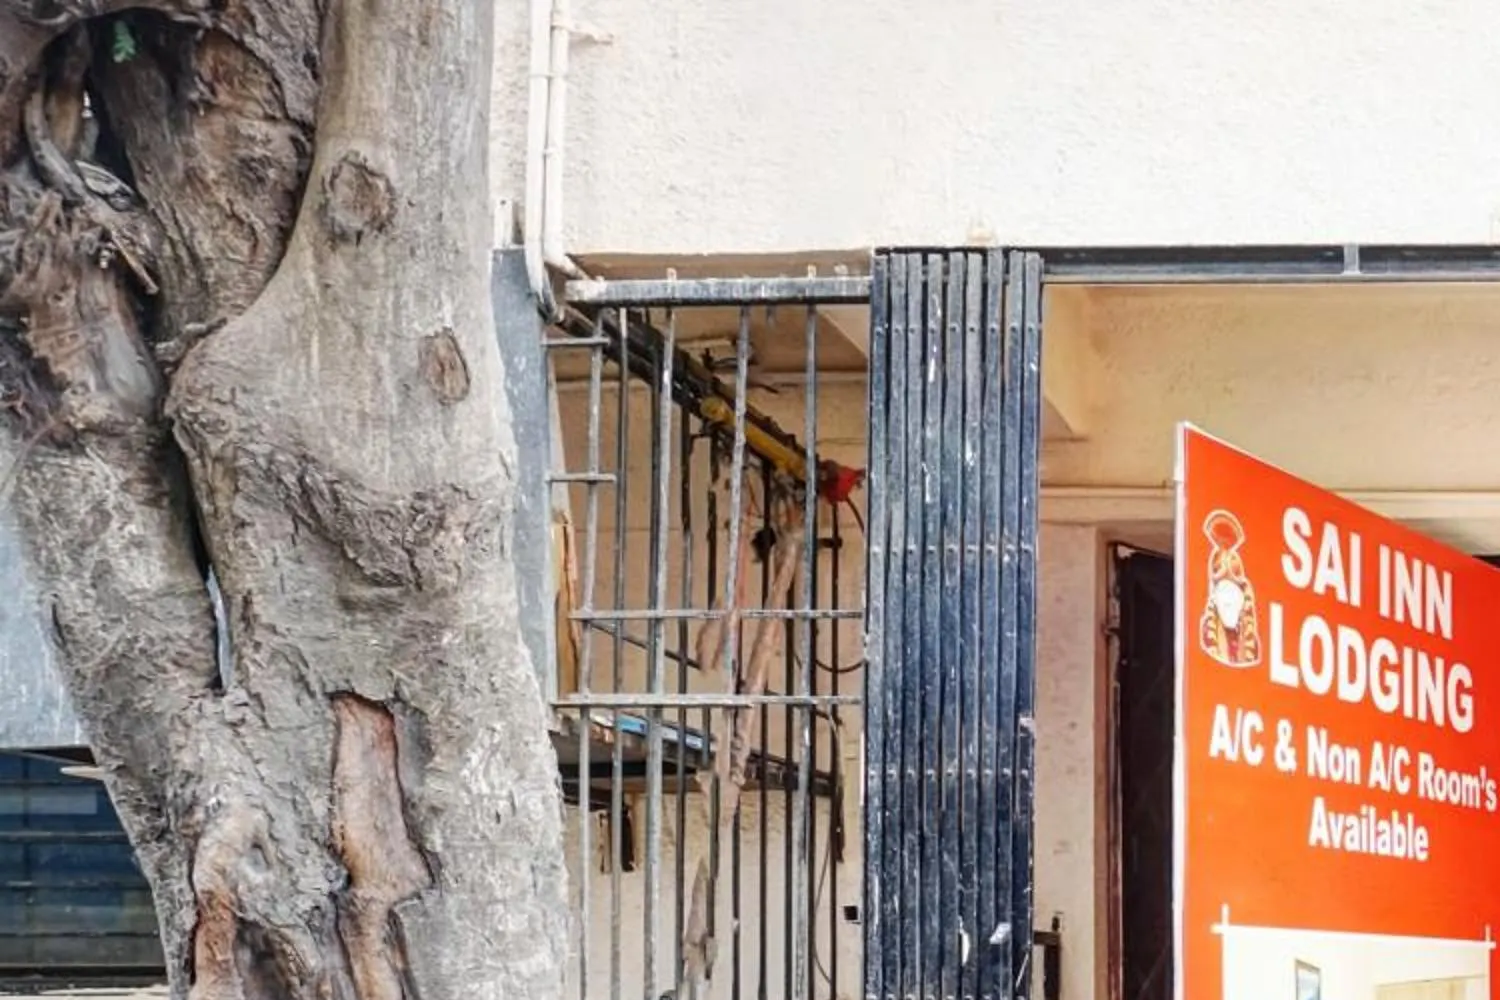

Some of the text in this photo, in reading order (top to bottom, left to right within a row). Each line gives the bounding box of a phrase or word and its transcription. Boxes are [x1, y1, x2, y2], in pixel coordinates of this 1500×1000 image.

[1281, 507, 1453, 639] SAI INN
[1269, 602, 1474, 733] LODGING
[1208, 703, 1498, 812] A/C & Non A/C Room's
[1308, 796, 1429, 862] Available
